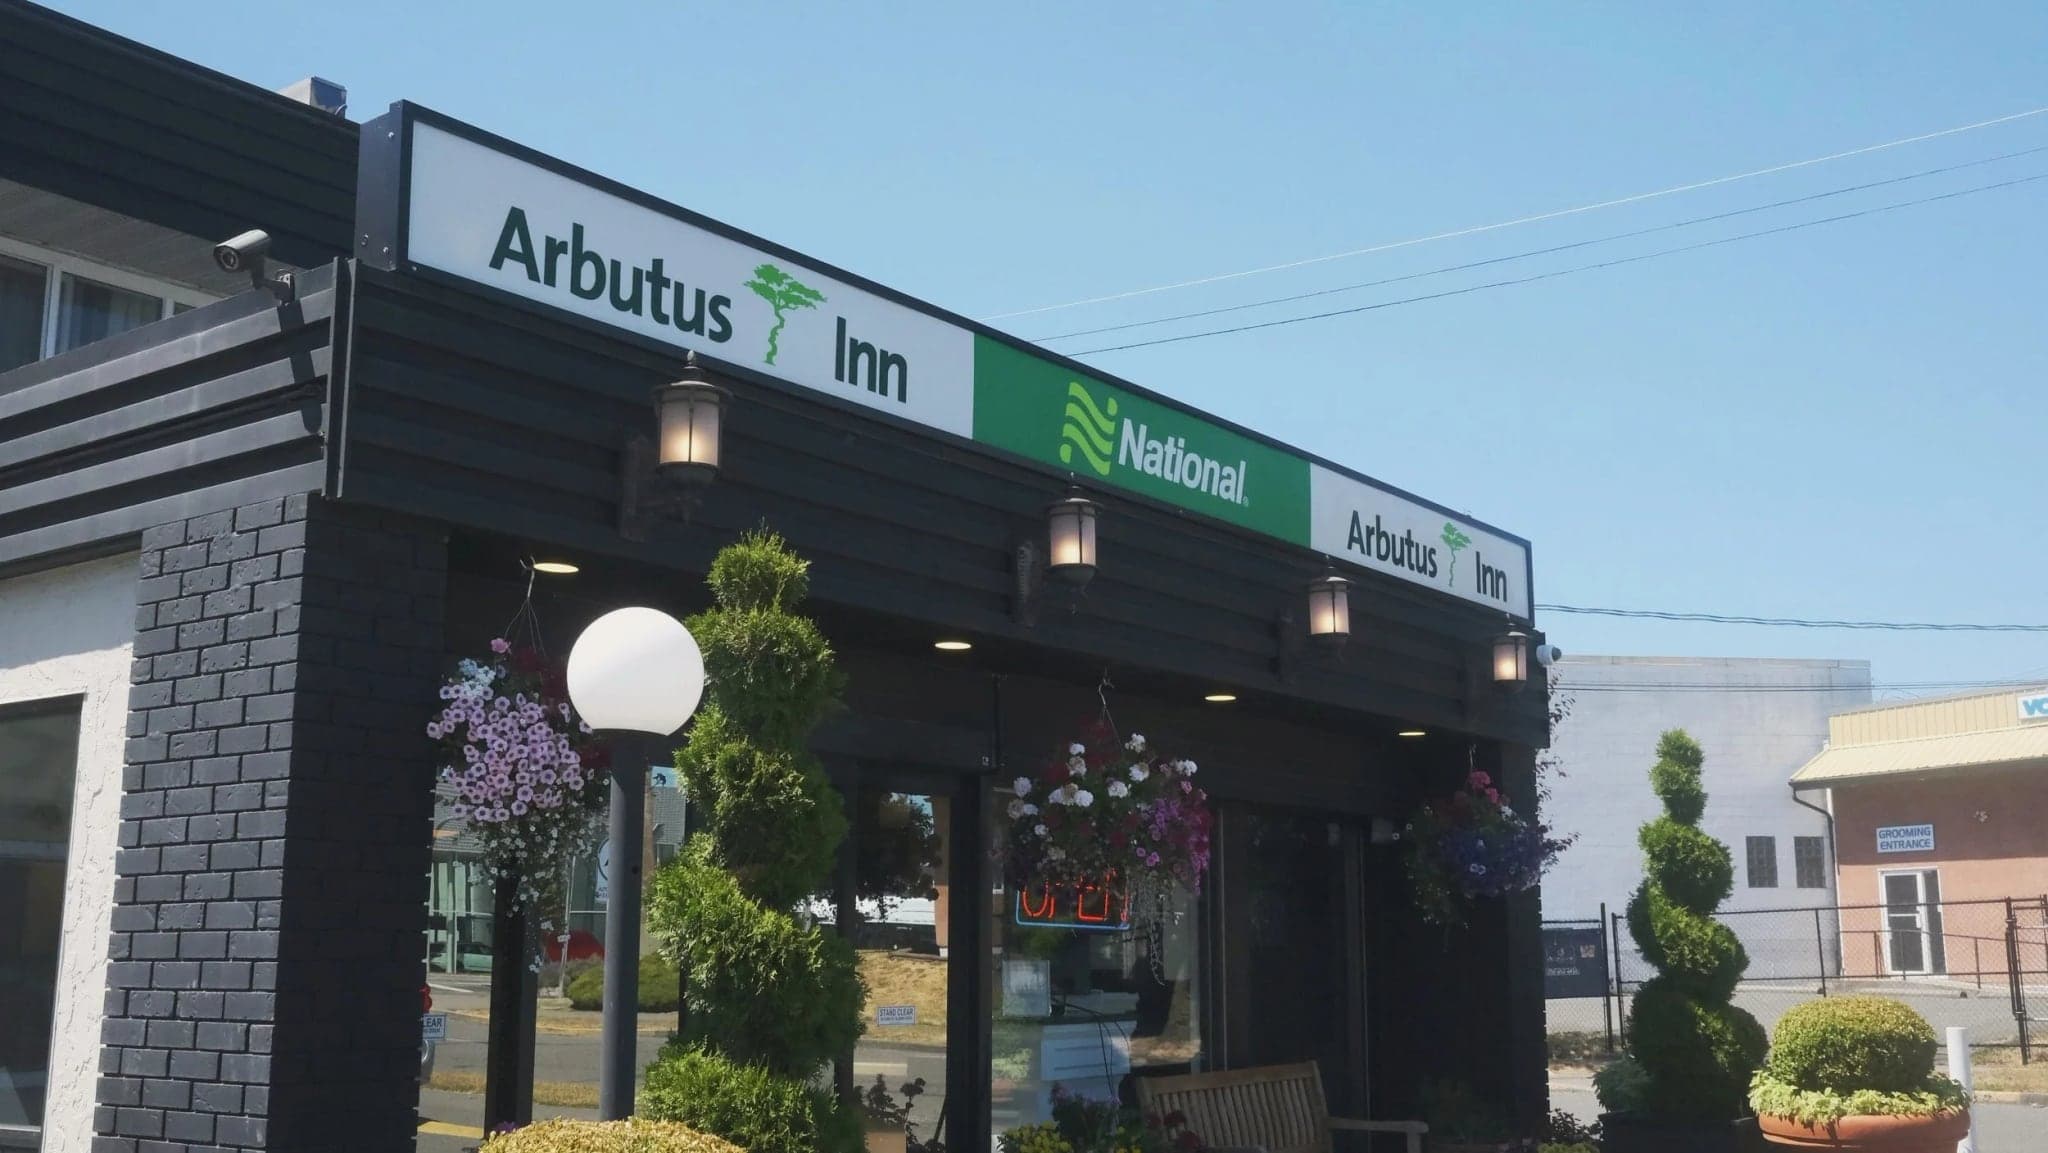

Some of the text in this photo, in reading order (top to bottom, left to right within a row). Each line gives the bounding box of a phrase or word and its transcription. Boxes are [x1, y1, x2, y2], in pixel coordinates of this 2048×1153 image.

[489, 206, 908, 403] Arbutus Inn
[1118, 417, 1247, 505] National
[1347, 510, 1508, 603] Arbutus Inn
[1879, 827, 1931, 839] GROOMING
[1880, 838, 1931, 850] ENTRANCE
